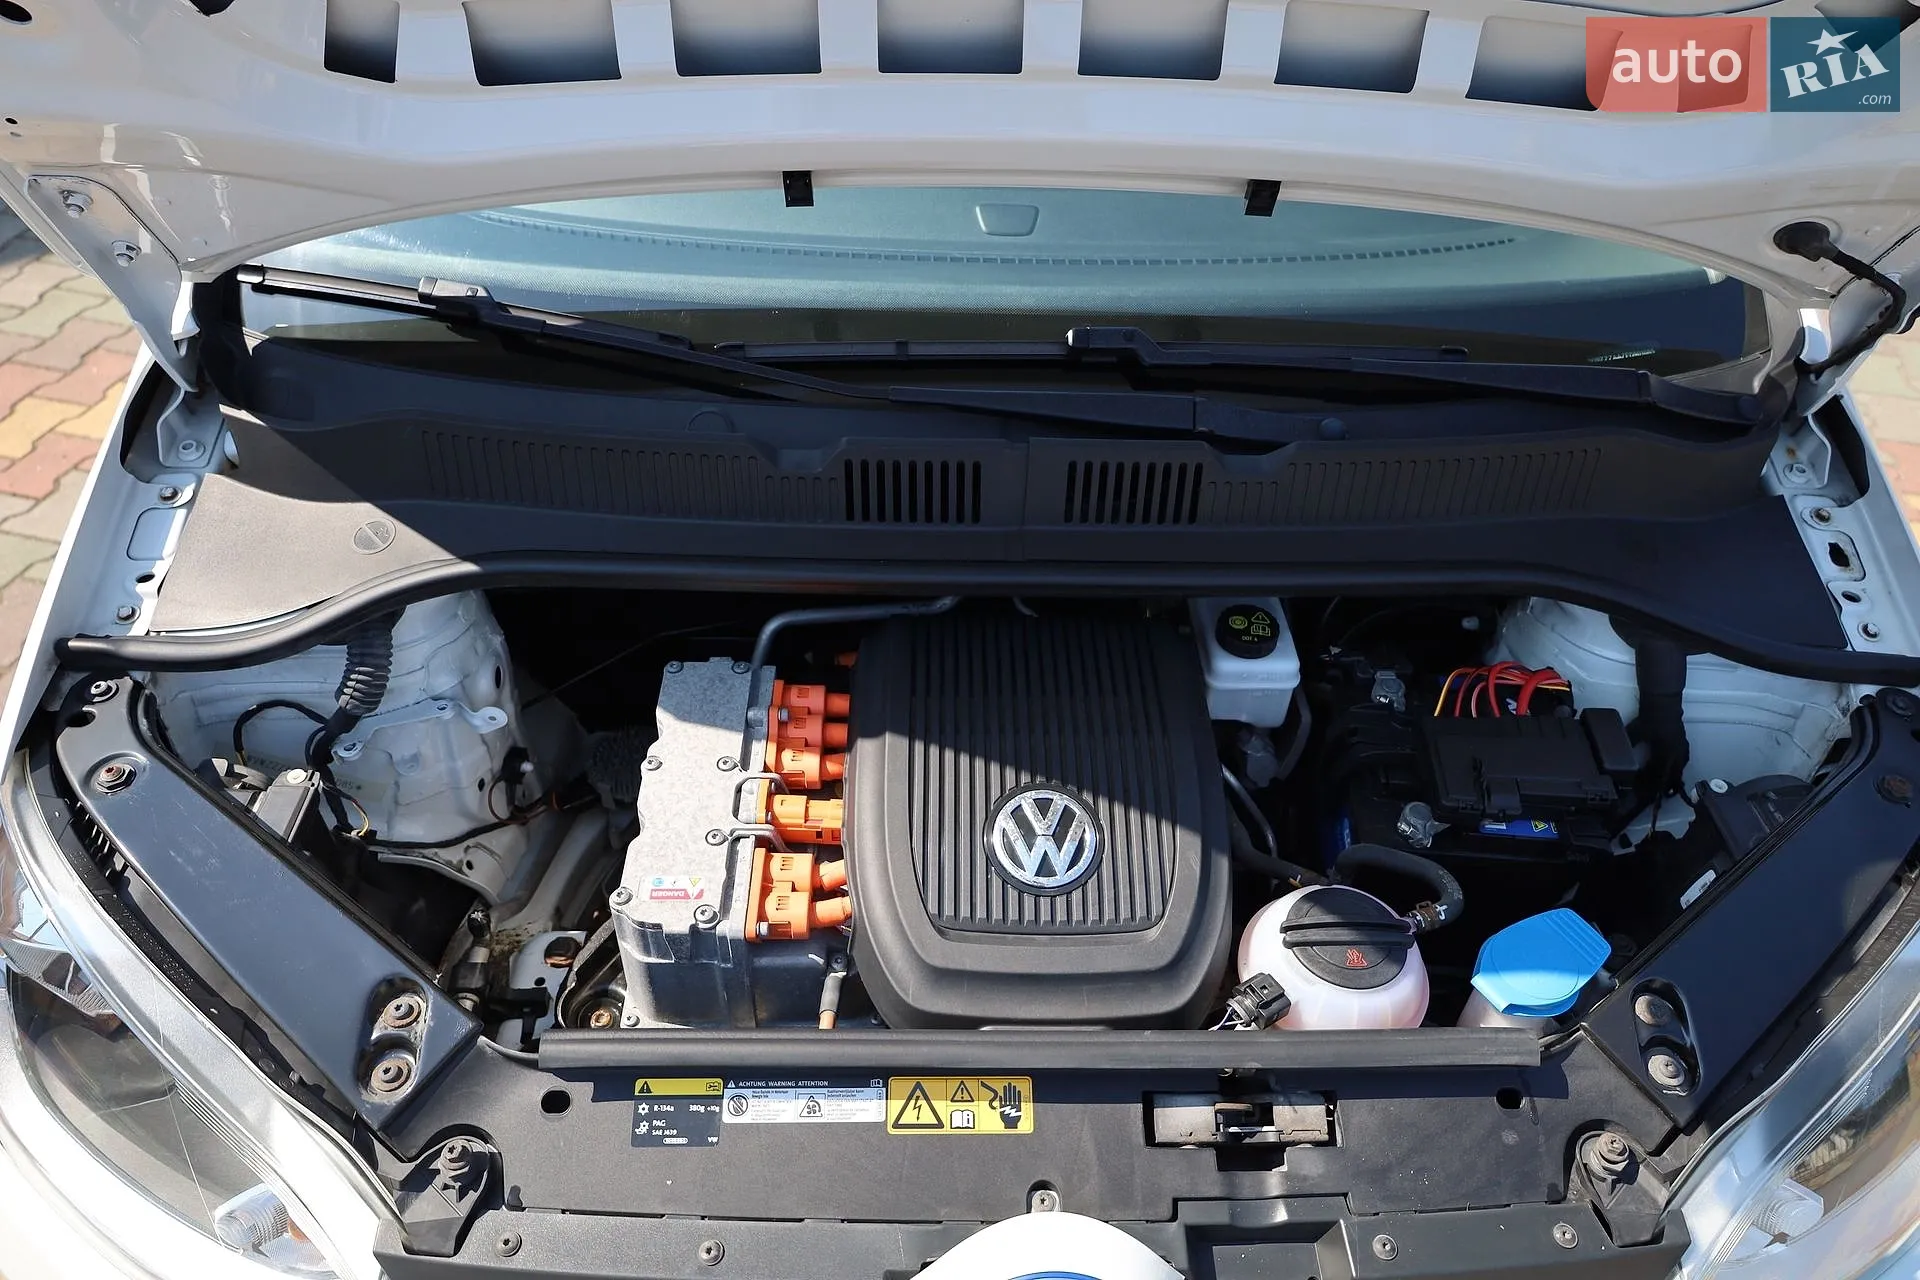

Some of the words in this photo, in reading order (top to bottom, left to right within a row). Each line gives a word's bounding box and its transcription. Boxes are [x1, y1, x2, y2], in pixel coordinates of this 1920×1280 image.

[653, 1104, 674, 1112] R-134a
[689, 1104, 706, 1113] 380g
[652, 1119, 666, 1127] PAG
